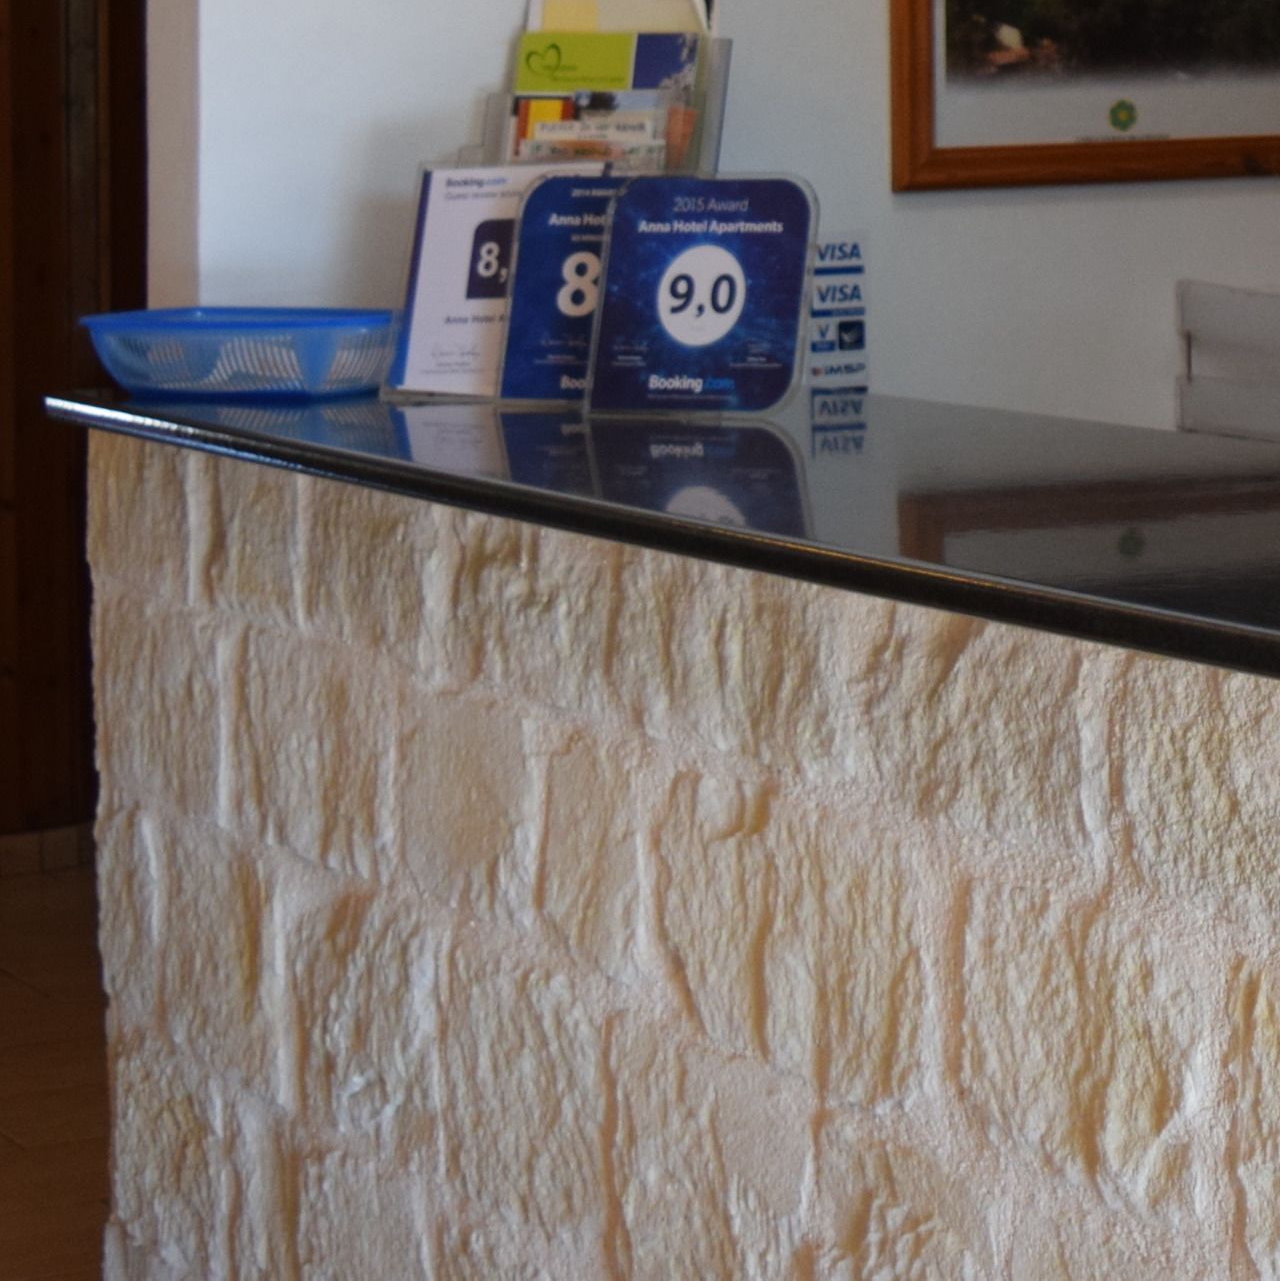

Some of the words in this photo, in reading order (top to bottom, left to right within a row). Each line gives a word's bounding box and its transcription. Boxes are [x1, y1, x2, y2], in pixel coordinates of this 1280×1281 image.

[672, 196, 705, 212] 2015
[707, 196, 750, 212] Award
[548, 213, 580, 227] Anna
[637, 219, 671, 234] Anna
[673, 219, 707, 234] Hotel
[709, 220, 784, 236] Apartments
[816, 241, 862, 262] VISA
[668, 272, 738, 319] 9,0
[816, 283, 862, 305] VISA
[647, 373, 735, 394] Booking.com
